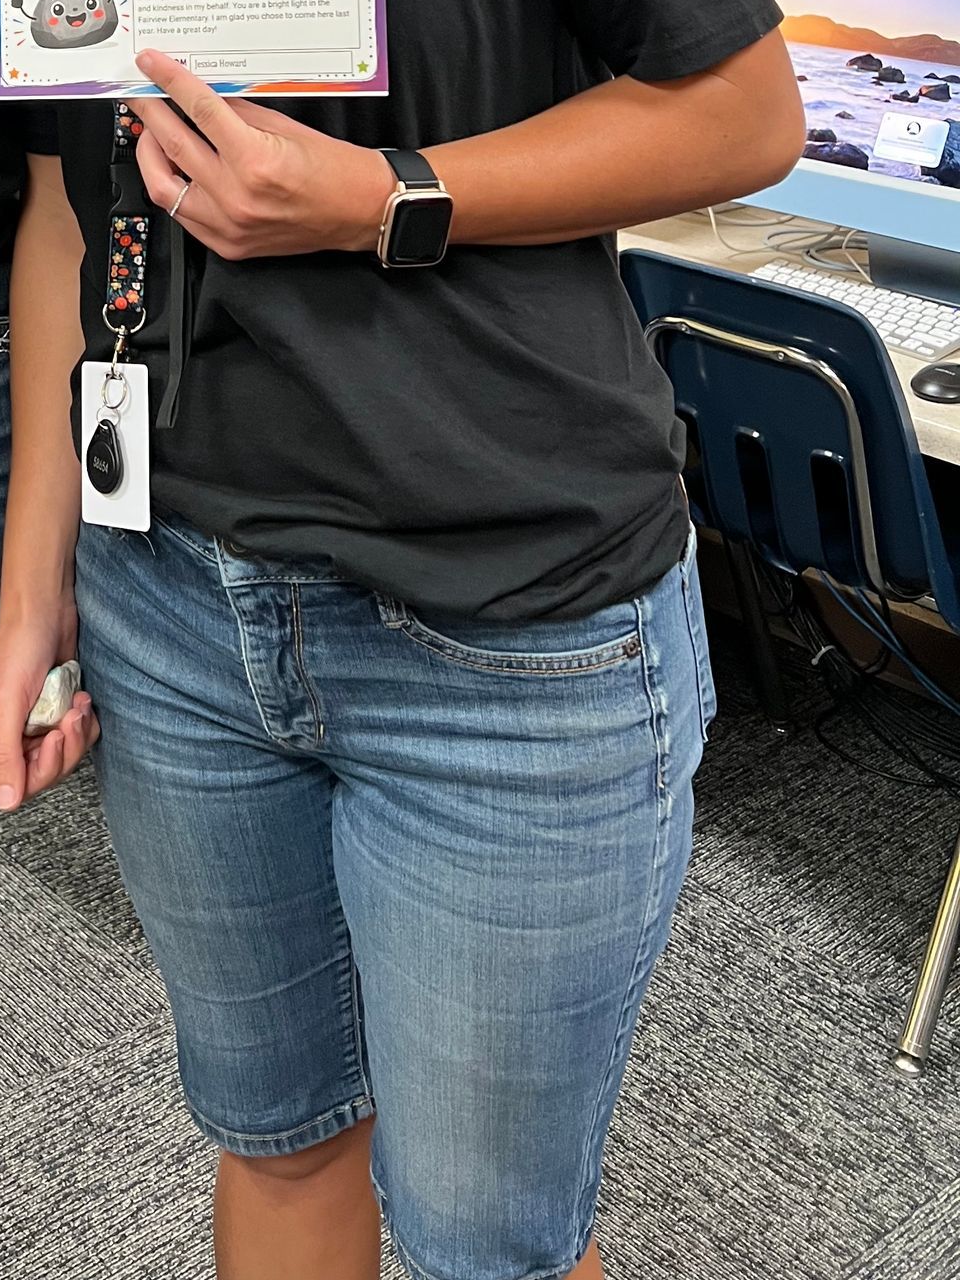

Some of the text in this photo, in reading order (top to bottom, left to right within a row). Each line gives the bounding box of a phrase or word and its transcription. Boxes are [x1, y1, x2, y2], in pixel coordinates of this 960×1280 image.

[194, 4, 204, 12] my
[268, 0, 289, 9] bright
[291, 0, 307, 8] light
[229, 14, 244, 22] glad
[246, 14, 260, 22] you
[183, 26, 201, 34] great
[195, 60, 218, 69] Jessica
[220, 59, 246, 68] Howard
